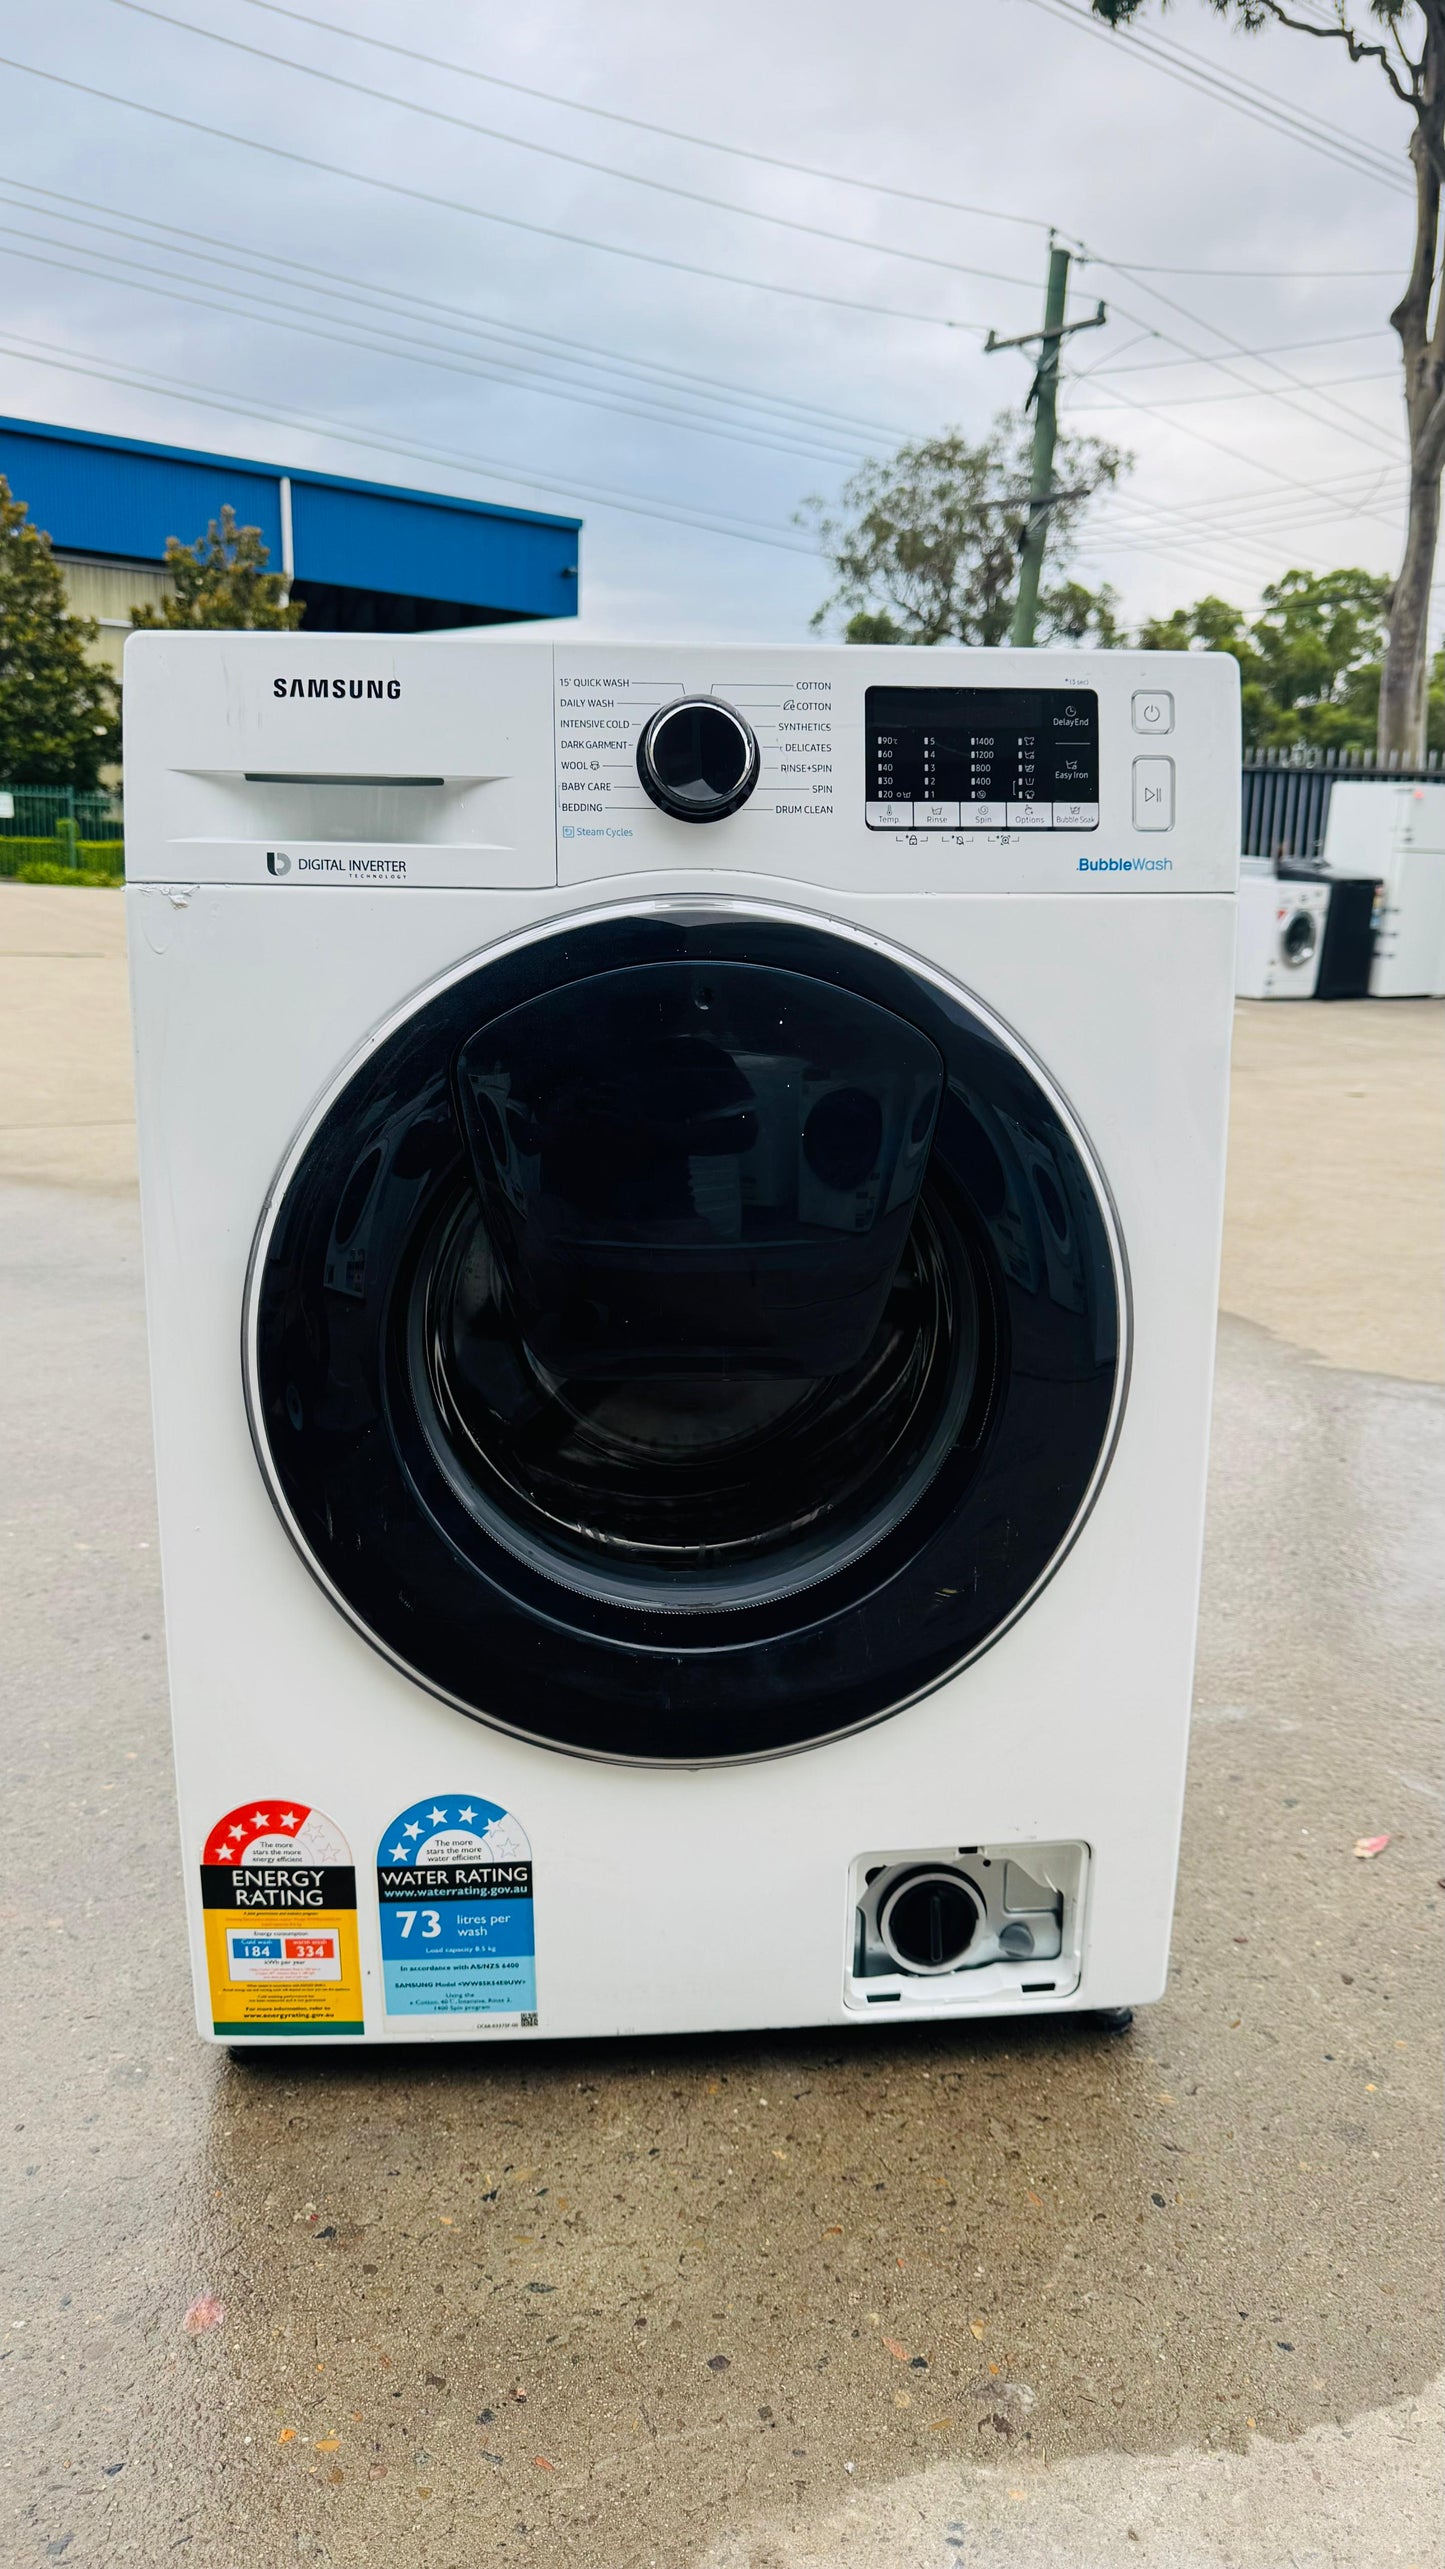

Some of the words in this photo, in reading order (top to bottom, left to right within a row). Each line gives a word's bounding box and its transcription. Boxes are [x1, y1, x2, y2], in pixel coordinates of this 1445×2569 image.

[573, 678, 602, 688] QUICK
[603, 678, 630, 688] WASH
[796, 681, 832, 690] COTTON
[273, 678, 401, 700] SAMSUNG
[560, 698, 586, 708] DAILY
[587, 698, 615, 708] WASH
[560, 719, 605, 729] INTENSIVE
[606, 720, 630, 729] COLD
[778, 722, 832, 732] SYNTHETICS
[561, 740, 585, 749] DARK
[585, 740, 628, 750] GARMENT
[930, 737, 936, 745] 5
[975, 737, 995, 746] 1400
[785, 743, 832, 753] DELICATES
[882, 750, 893, 758] 60
[930, 750, 936, 758] 4
[975, 750, 995, 759] 1200
[561, 761, 588, 770] WOOL
[780, 763, 833, 773] RINSE+SPIN
[882, 763, 893, 772] 40
[930, 763, 936, 772] 3
[975, 763, 991, 772] 800
[1055, 771, 1073, 780] Easy
[1073, 771, 1089, 780] Iron
[882, 777, 893, 785] 30
[930, 777, 936, 786] 2
[975, 777, 991, 786] 400
[561, 782, 585, 791] BABY
[587, 782, 612, 792] CARE
[812, 784, 833, 794] SPIN
[882, 790, 893, 799] 20
[561, 803, 603, 812] BEDDING
[775, 805, 802, 814] DRUM
[803, 805, 834, 815] CLEAN
[879, 816, 899, 825] Temp
[926, 816, 948, 824] Rinse
[975, 816, 992, 825] Spin
[1015, 815, 1045, 825] Options
[1056, 816, 1079, 824] Bubble
[1080, 816, 1095, 824] Soak
[576, 827, 604, 837] Steam
[605, 827, 634, 839] Cycles
[298, 858, 346, 871] DIGITAL
[348, 859, 407, 873] INVERTER
[1078, 857, 1173, 872] BubbleWash
[435, 1839, 451, 1847] The
[252, 1855, 275, 1863] energy
[276, 1855, 303, 1863] efficient
[451, 1854, 481, 1862] efficient
[232, 1869, 325, 1888] ENERGY
[381, 1870, 449, 1886] WATER
[455, 1867, 529, 1885] RATING
[384, 1885, 529, 1898] www.waterrating.gov.au
[235, 1889, 324, 1907] RATING
[395, 1910, 442, 1938] 73
[456, 1914, 487, 1925] litres
[490, 1914, 512, 1926] per
[457, 1926, 488, 1937] wash
[243, 1946, 270, 1957] 184
[296, 1946, 325, 1957] 334
